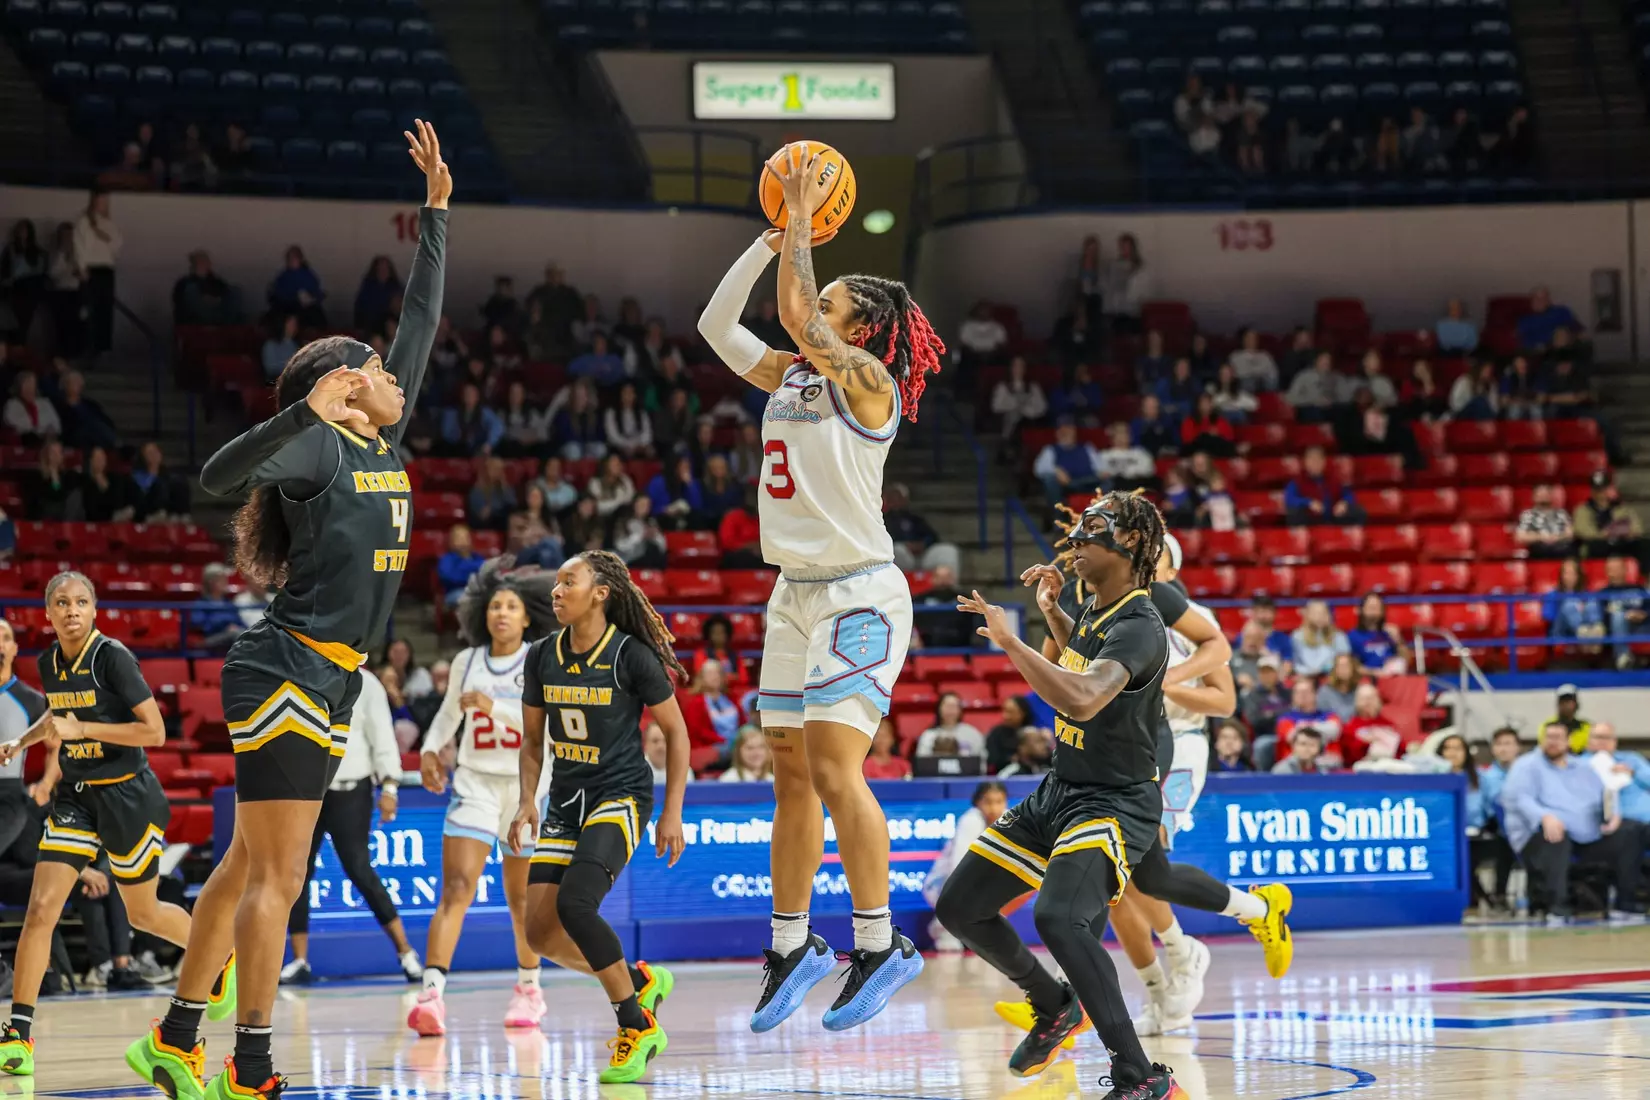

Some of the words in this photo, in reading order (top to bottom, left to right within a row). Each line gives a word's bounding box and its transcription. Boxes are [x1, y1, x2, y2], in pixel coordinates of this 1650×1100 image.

[707, 75, 777, 106] Super
[783, 73, 802, 112] 1
[806, 77, 880, 100] Foods
[393, 211, 420, 243] 10
[764, 439, 796, 499] 3
[388, 498, 409, 543] 4
[554, 742, 600, 765] STATE
[1226, 803, 1312, 843] Ivan
[1320, 797, 1430, 842] Smith
[1228, 845, 1429, 876] FURNITURE
